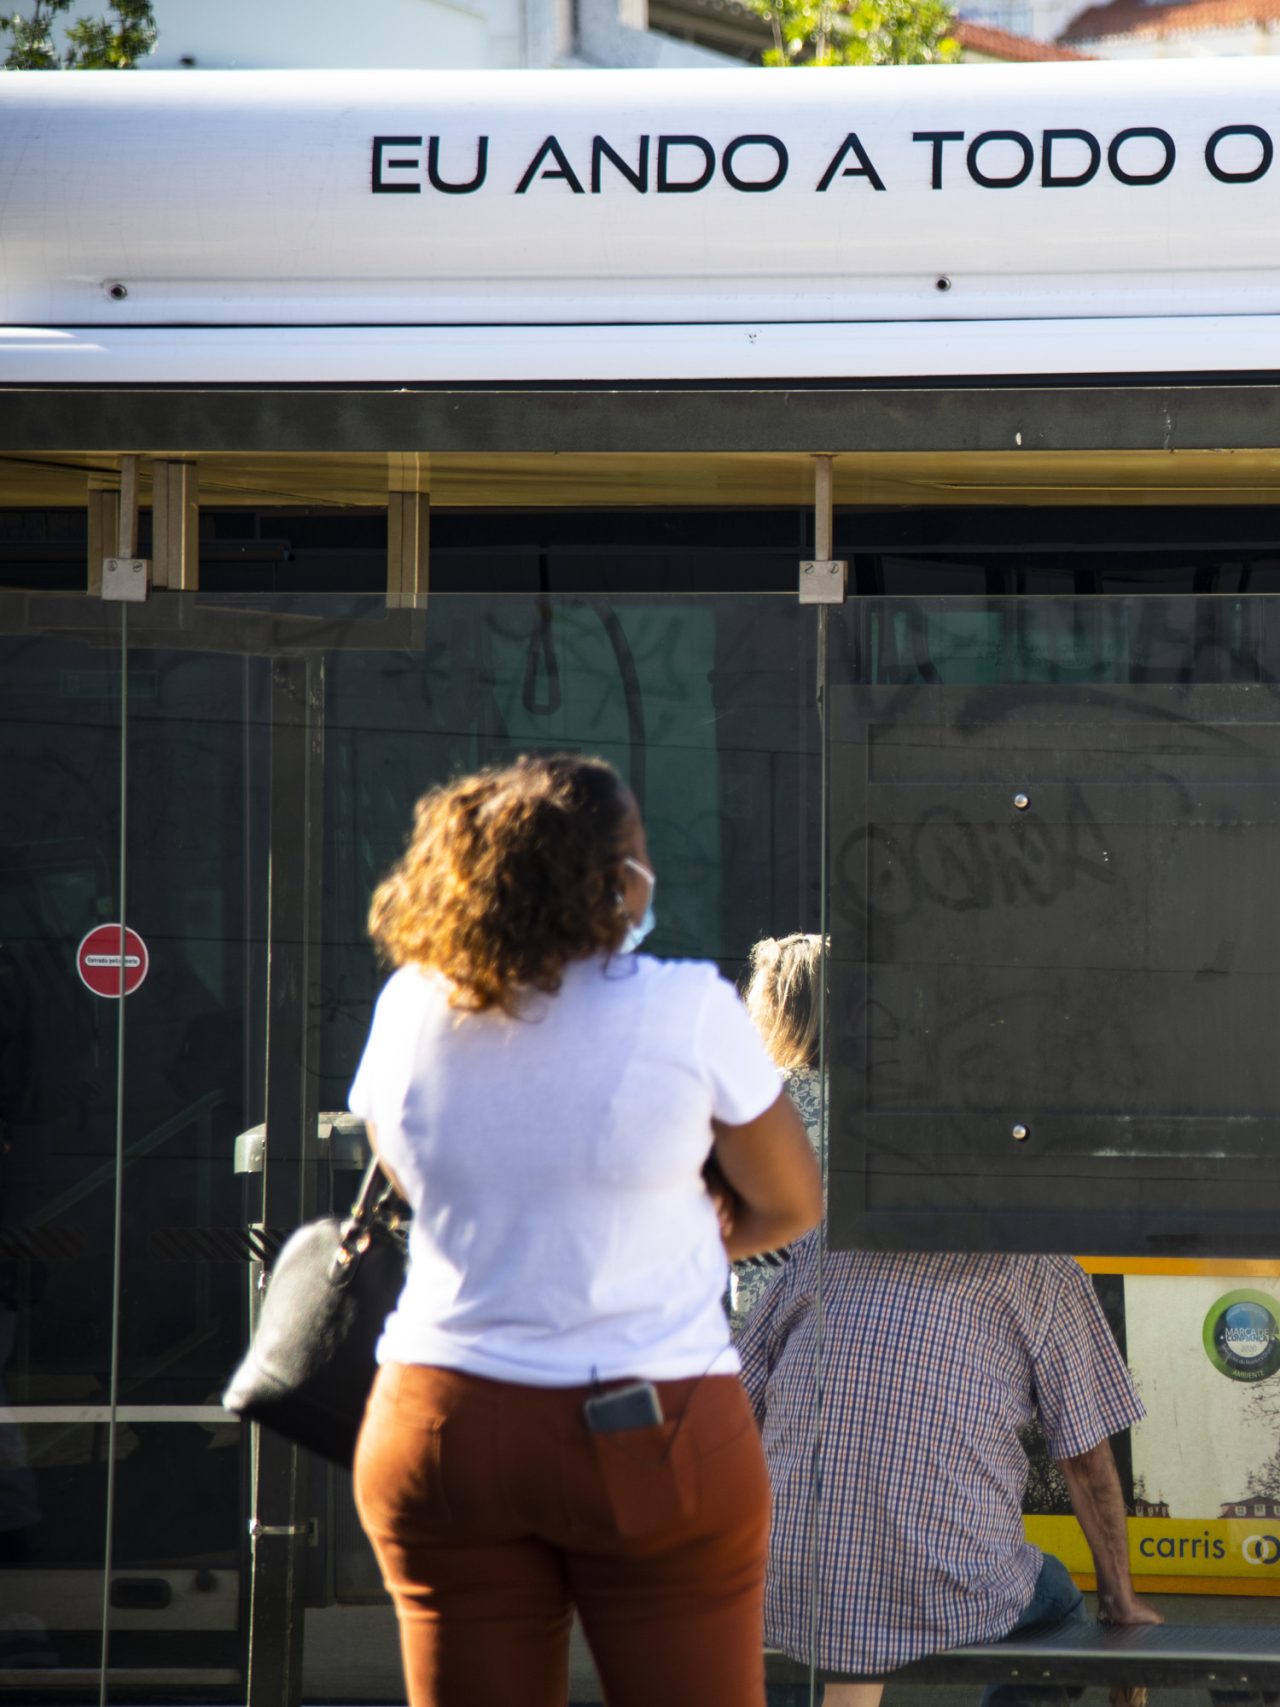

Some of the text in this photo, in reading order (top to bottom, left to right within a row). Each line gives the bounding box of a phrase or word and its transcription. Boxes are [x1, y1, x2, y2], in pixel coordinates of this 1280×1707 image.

[370, 135, 489, 195] EU
[514, 133, 789, 195] ANDO
[815, 132, 887, 193] A
[912, 126, 1177, 190] TODO
[1204, 124, 1274, 184] O
[1225, 1327, 1257, 1336] MARCA
[1139, 1530, 1226, 1560] carris
